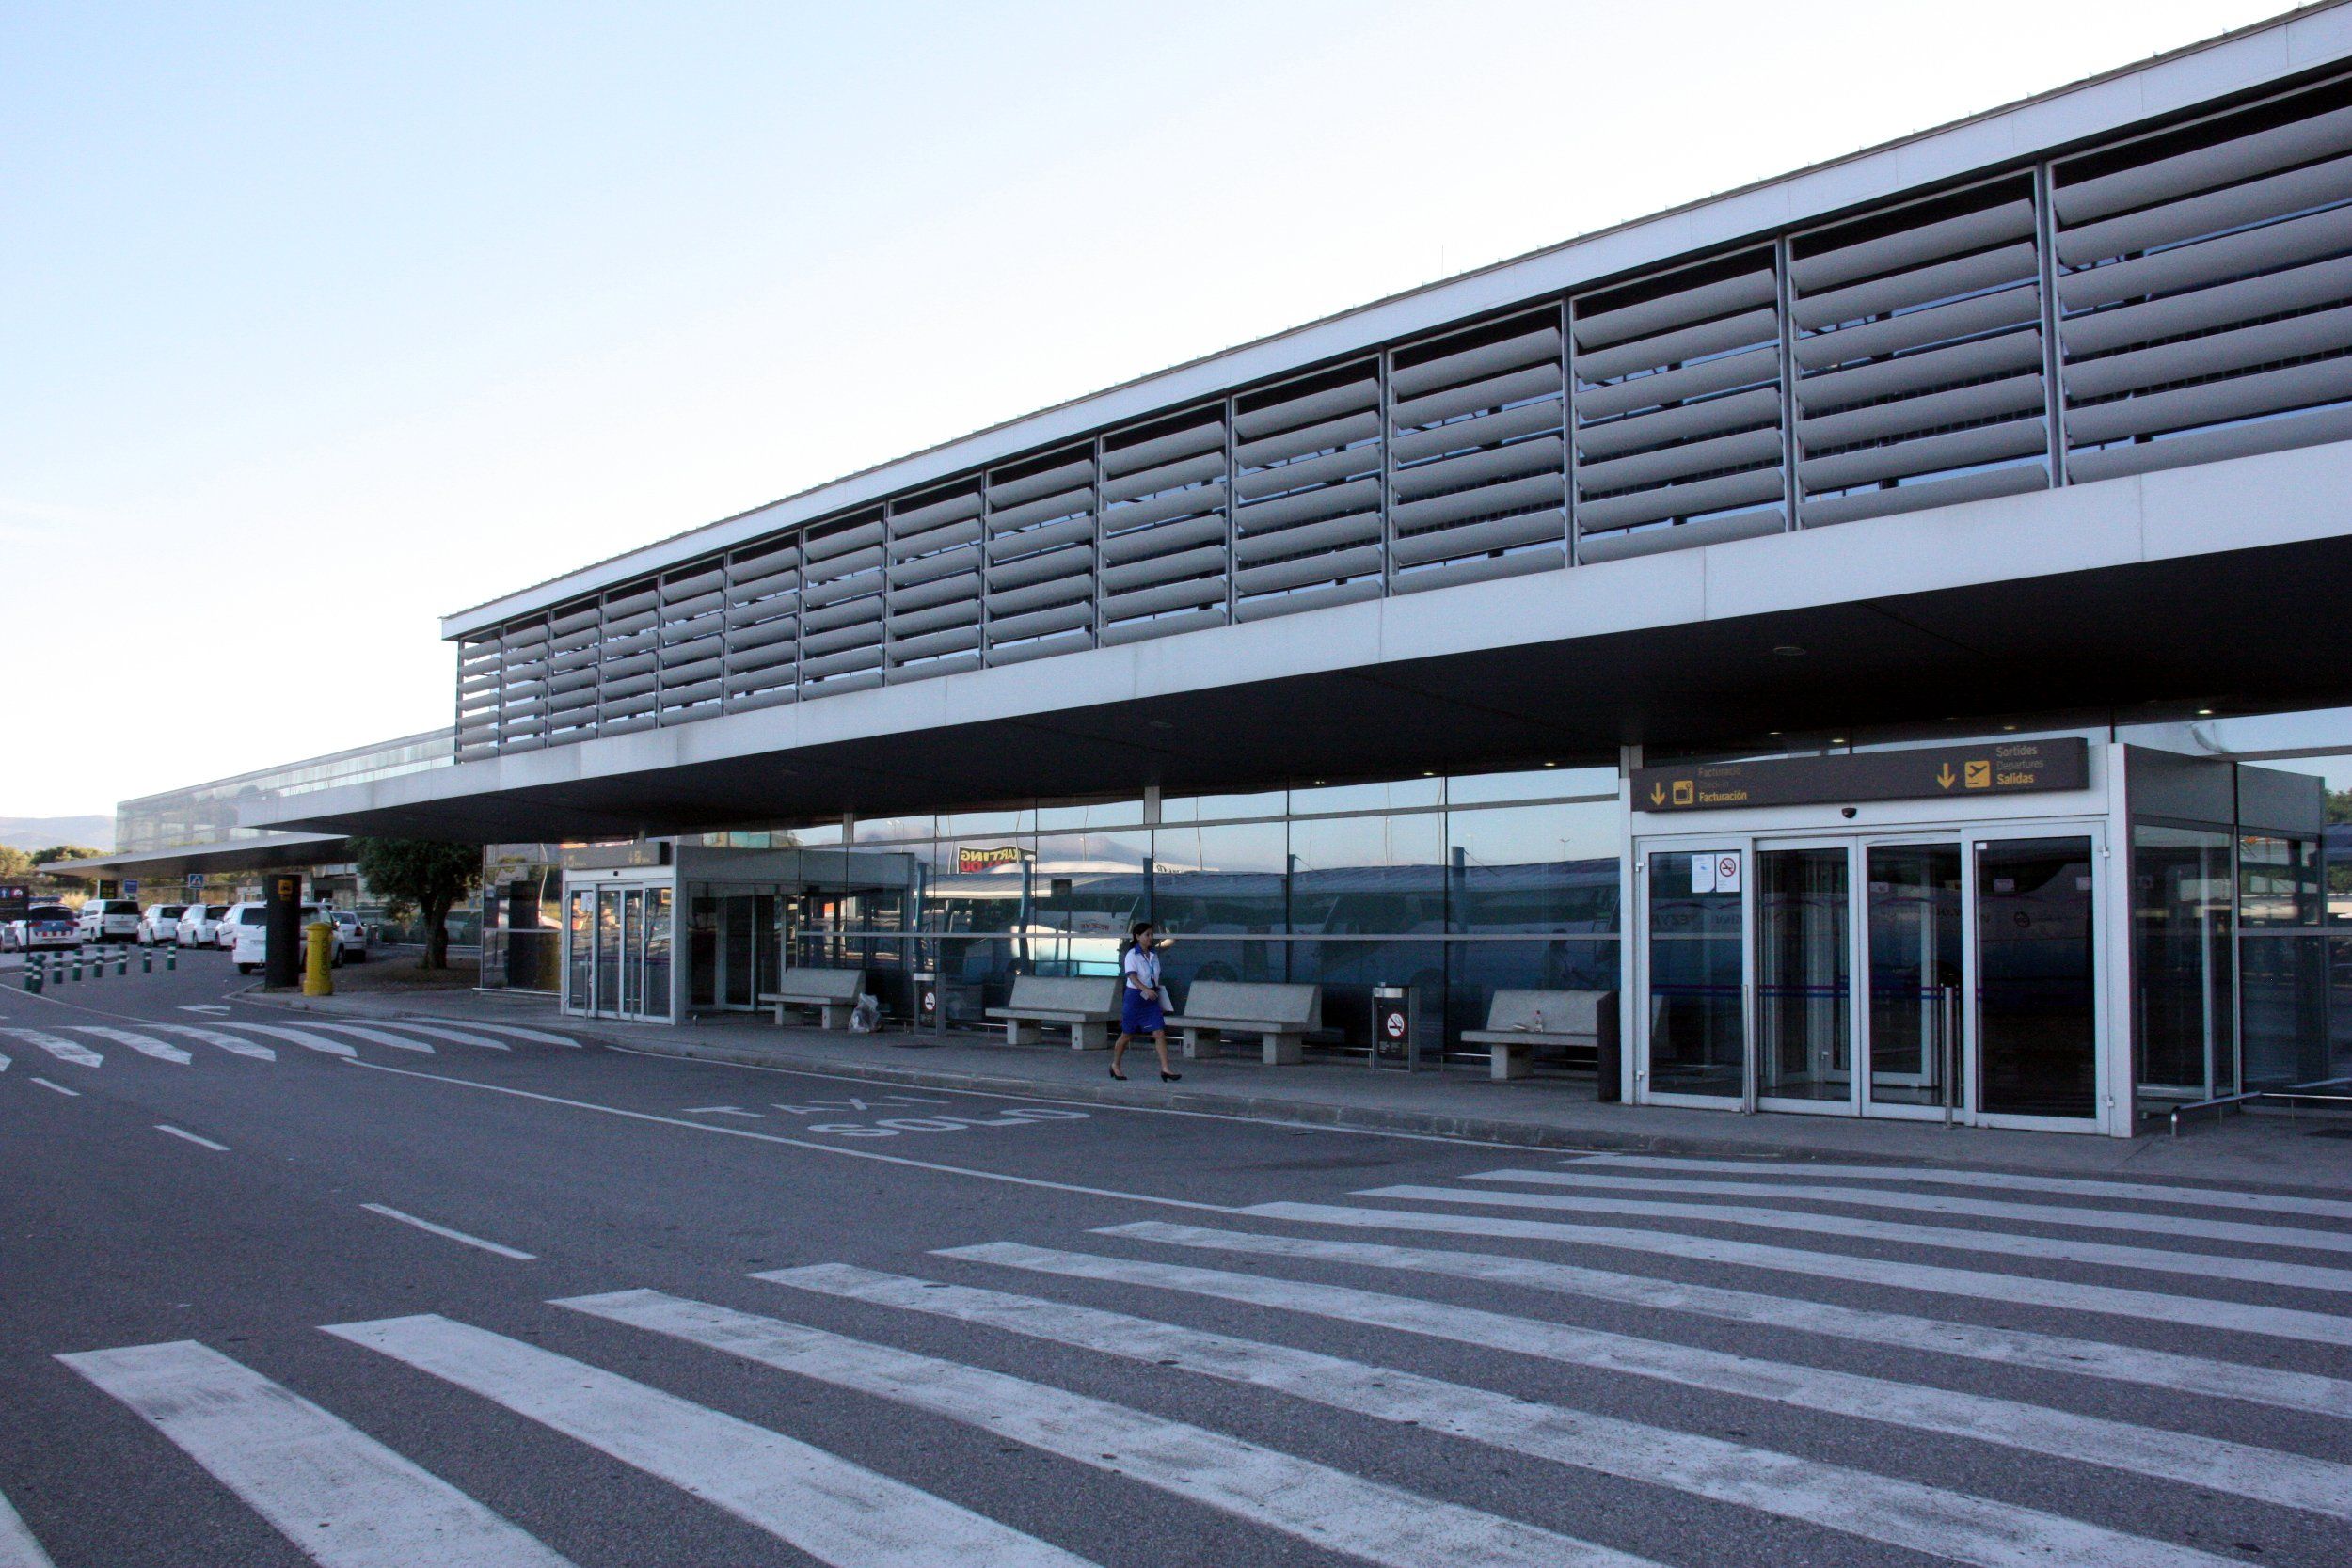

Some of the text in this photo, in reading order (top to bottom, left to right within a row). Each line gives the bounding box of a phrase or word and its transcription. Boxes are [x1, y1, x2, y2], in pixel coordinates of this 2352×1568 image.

[1995, 745, 2038, 757] Sortides
[1996, 772, 2034, 785] Salidas
[1699, 790, 1747, 802] Facturación
[681, 1096, 950, 1117] TAXI
[807, 1108, 1090, 1137] SOLO
